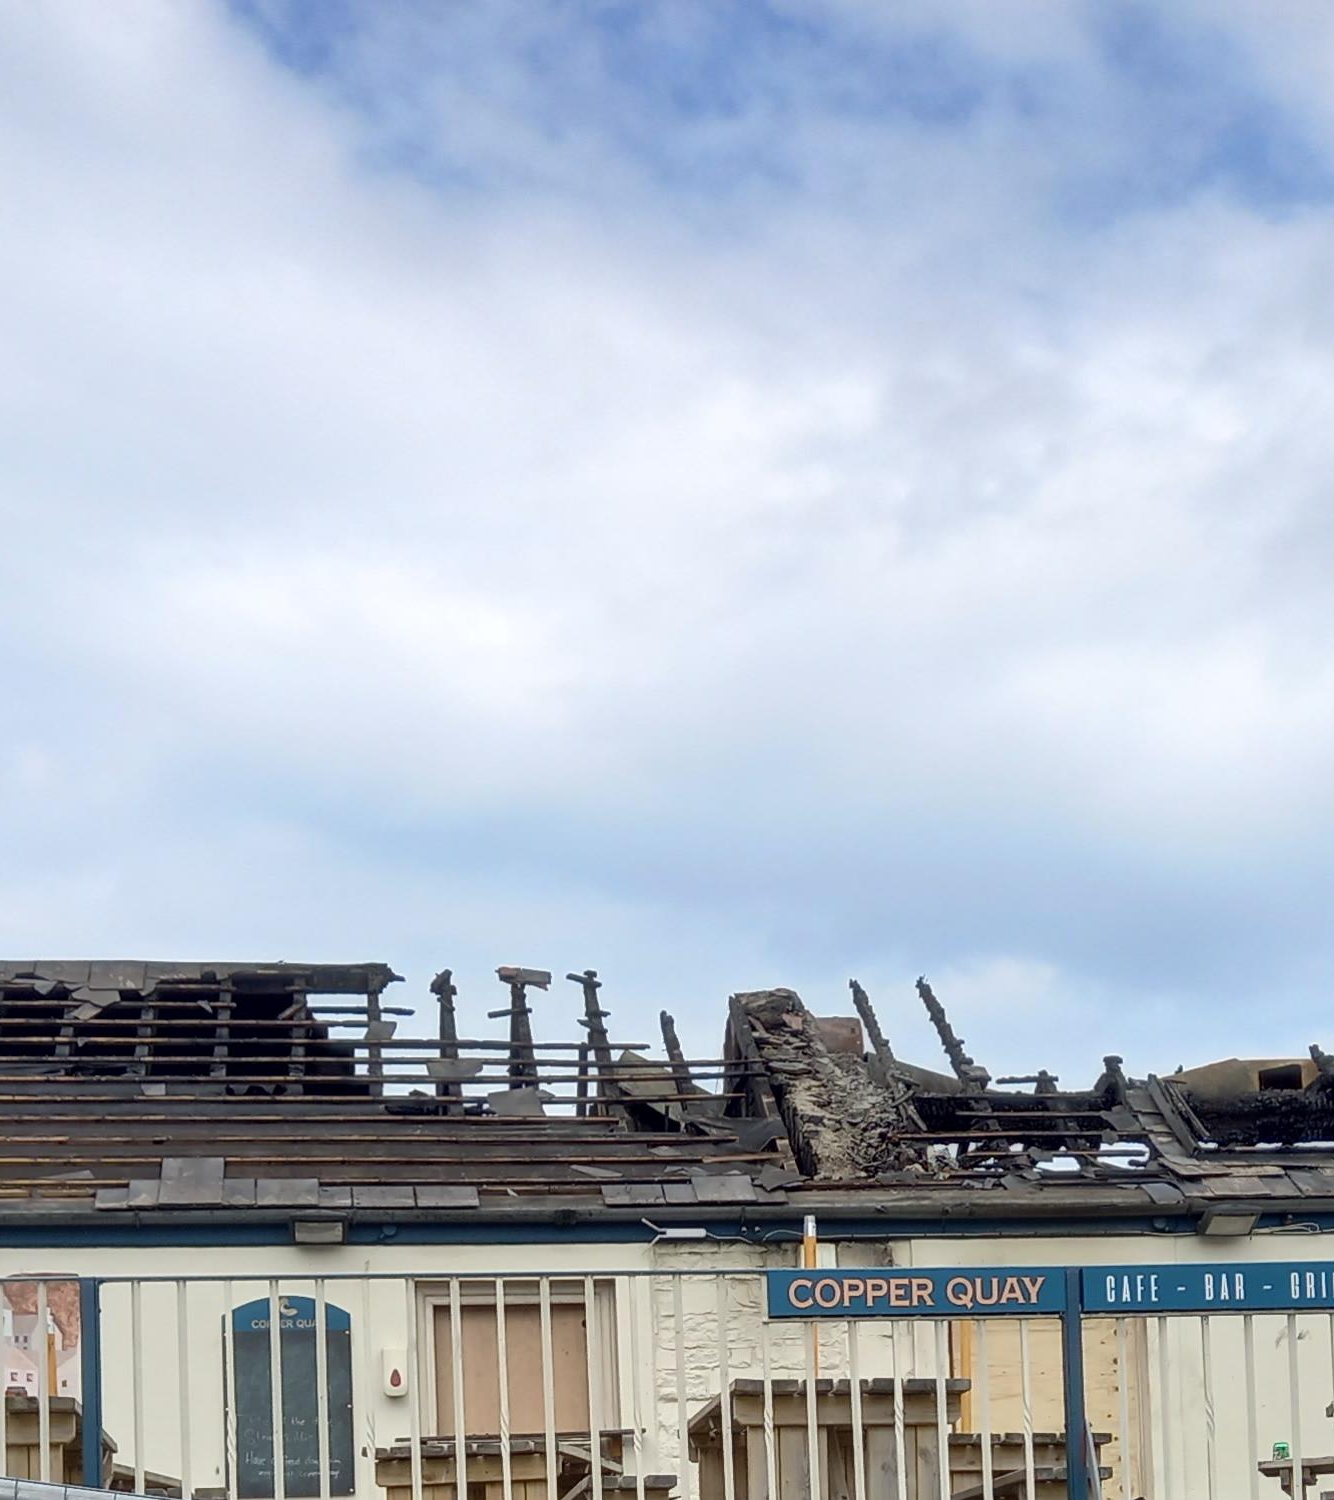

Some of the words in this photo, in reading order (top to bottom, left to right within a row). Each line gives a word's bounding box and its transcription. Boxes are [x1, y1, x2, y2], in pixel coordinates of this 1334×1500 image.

[788, 1278, 934, 1309] COPPER
[946, 1277, 1046, 1309] QUAY
[1106, 1274, 1159, 1302] CAFE
[1204, 1273, 1245, 1301] BAR
